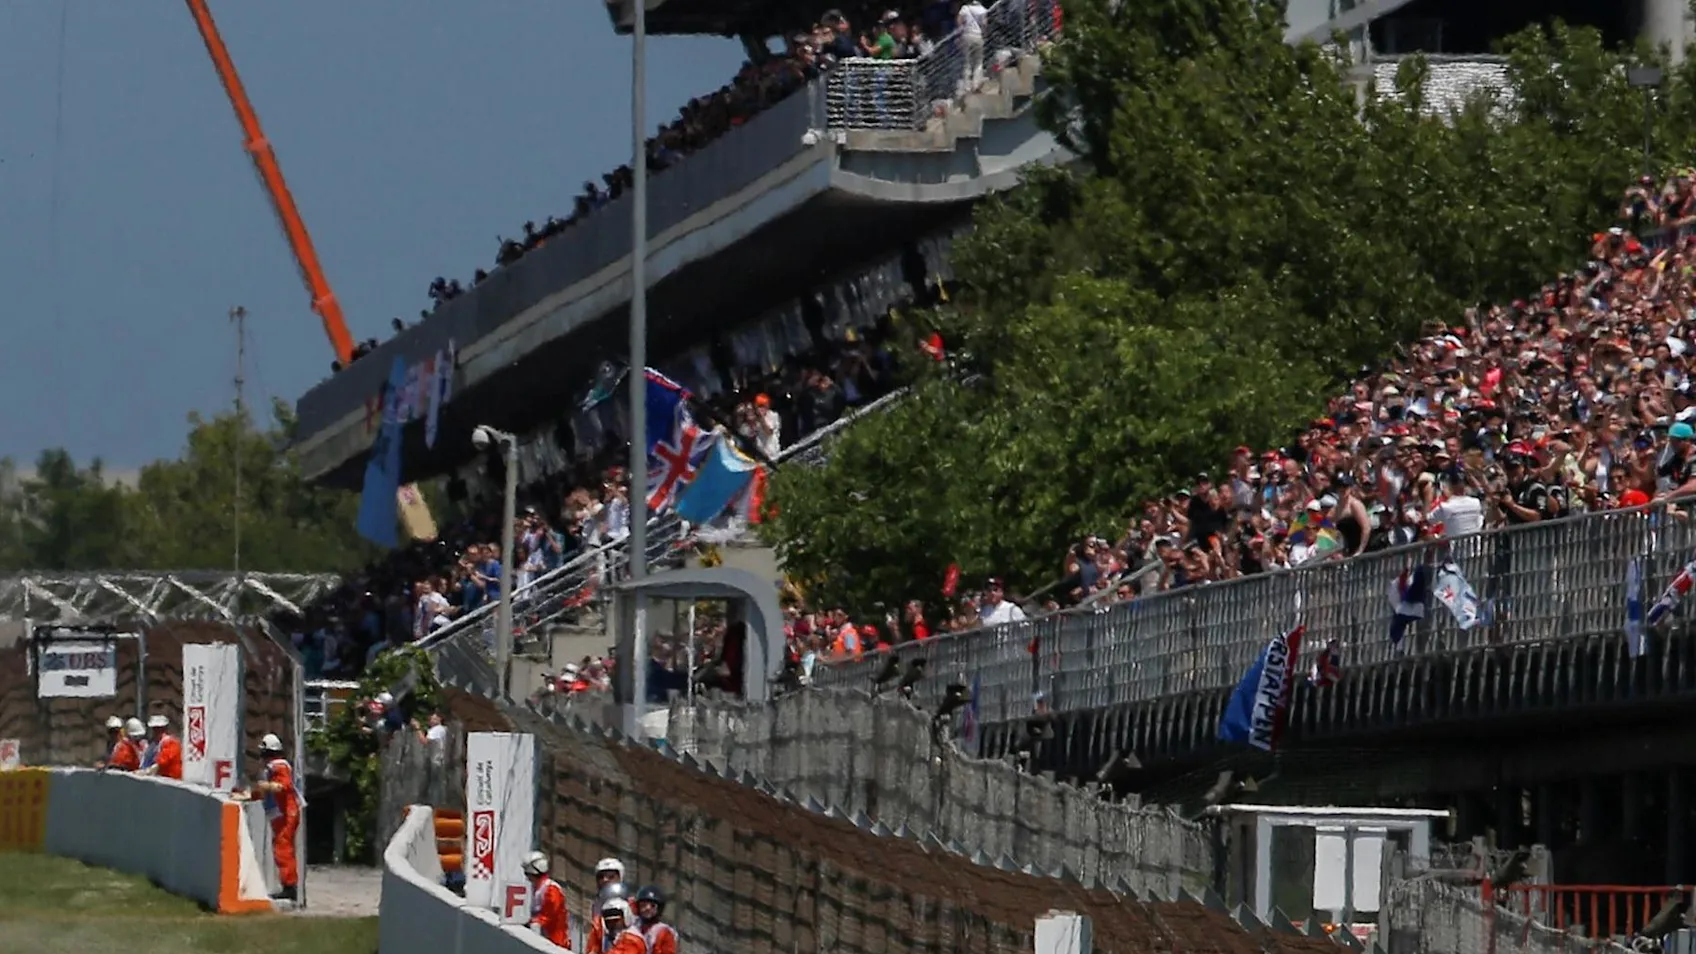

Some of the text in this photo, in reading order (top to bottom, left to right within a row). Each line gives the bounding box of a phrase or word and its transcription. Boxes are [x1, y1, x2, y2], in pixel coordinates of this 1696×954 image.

[1253, 636, 1289, 745] RSTAPPEN
[215, 761, 232, 788] F
[505, 886, 526, 917] F
